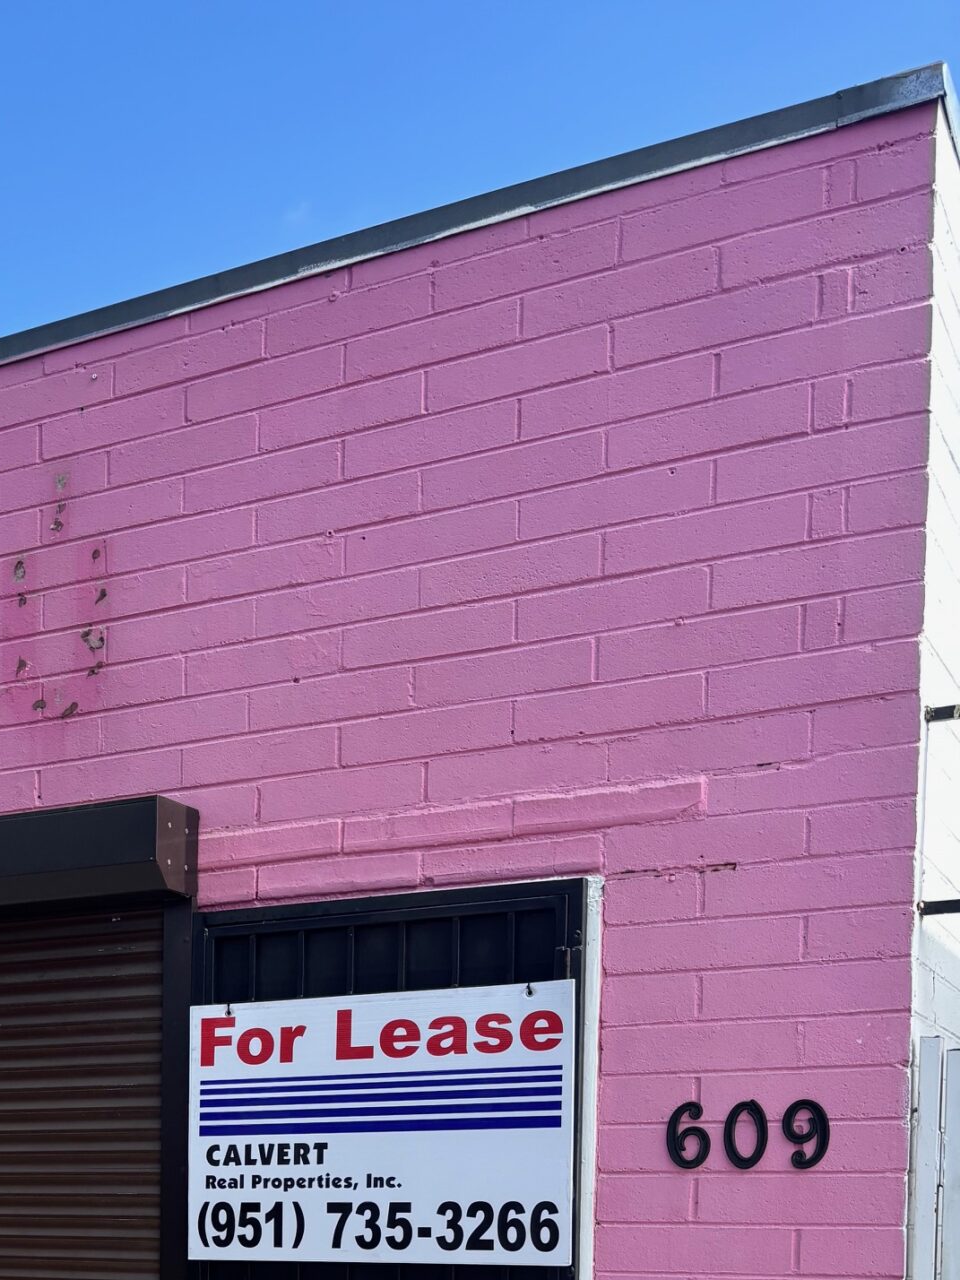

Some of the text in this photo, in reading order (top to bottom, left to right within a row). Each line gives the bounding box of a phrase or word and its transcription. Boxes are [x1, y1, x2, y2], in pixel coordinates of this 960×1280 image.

[200, 1008, 564, 1067] For Lease
[205, 1142, 328, 1167] CALVERT
[666, 1099, 830, 1169] 609
[205, 1173, 402, 1192] Real Properties, Inc.
[197, 1201, 560, 1252] (951) 735-3266
